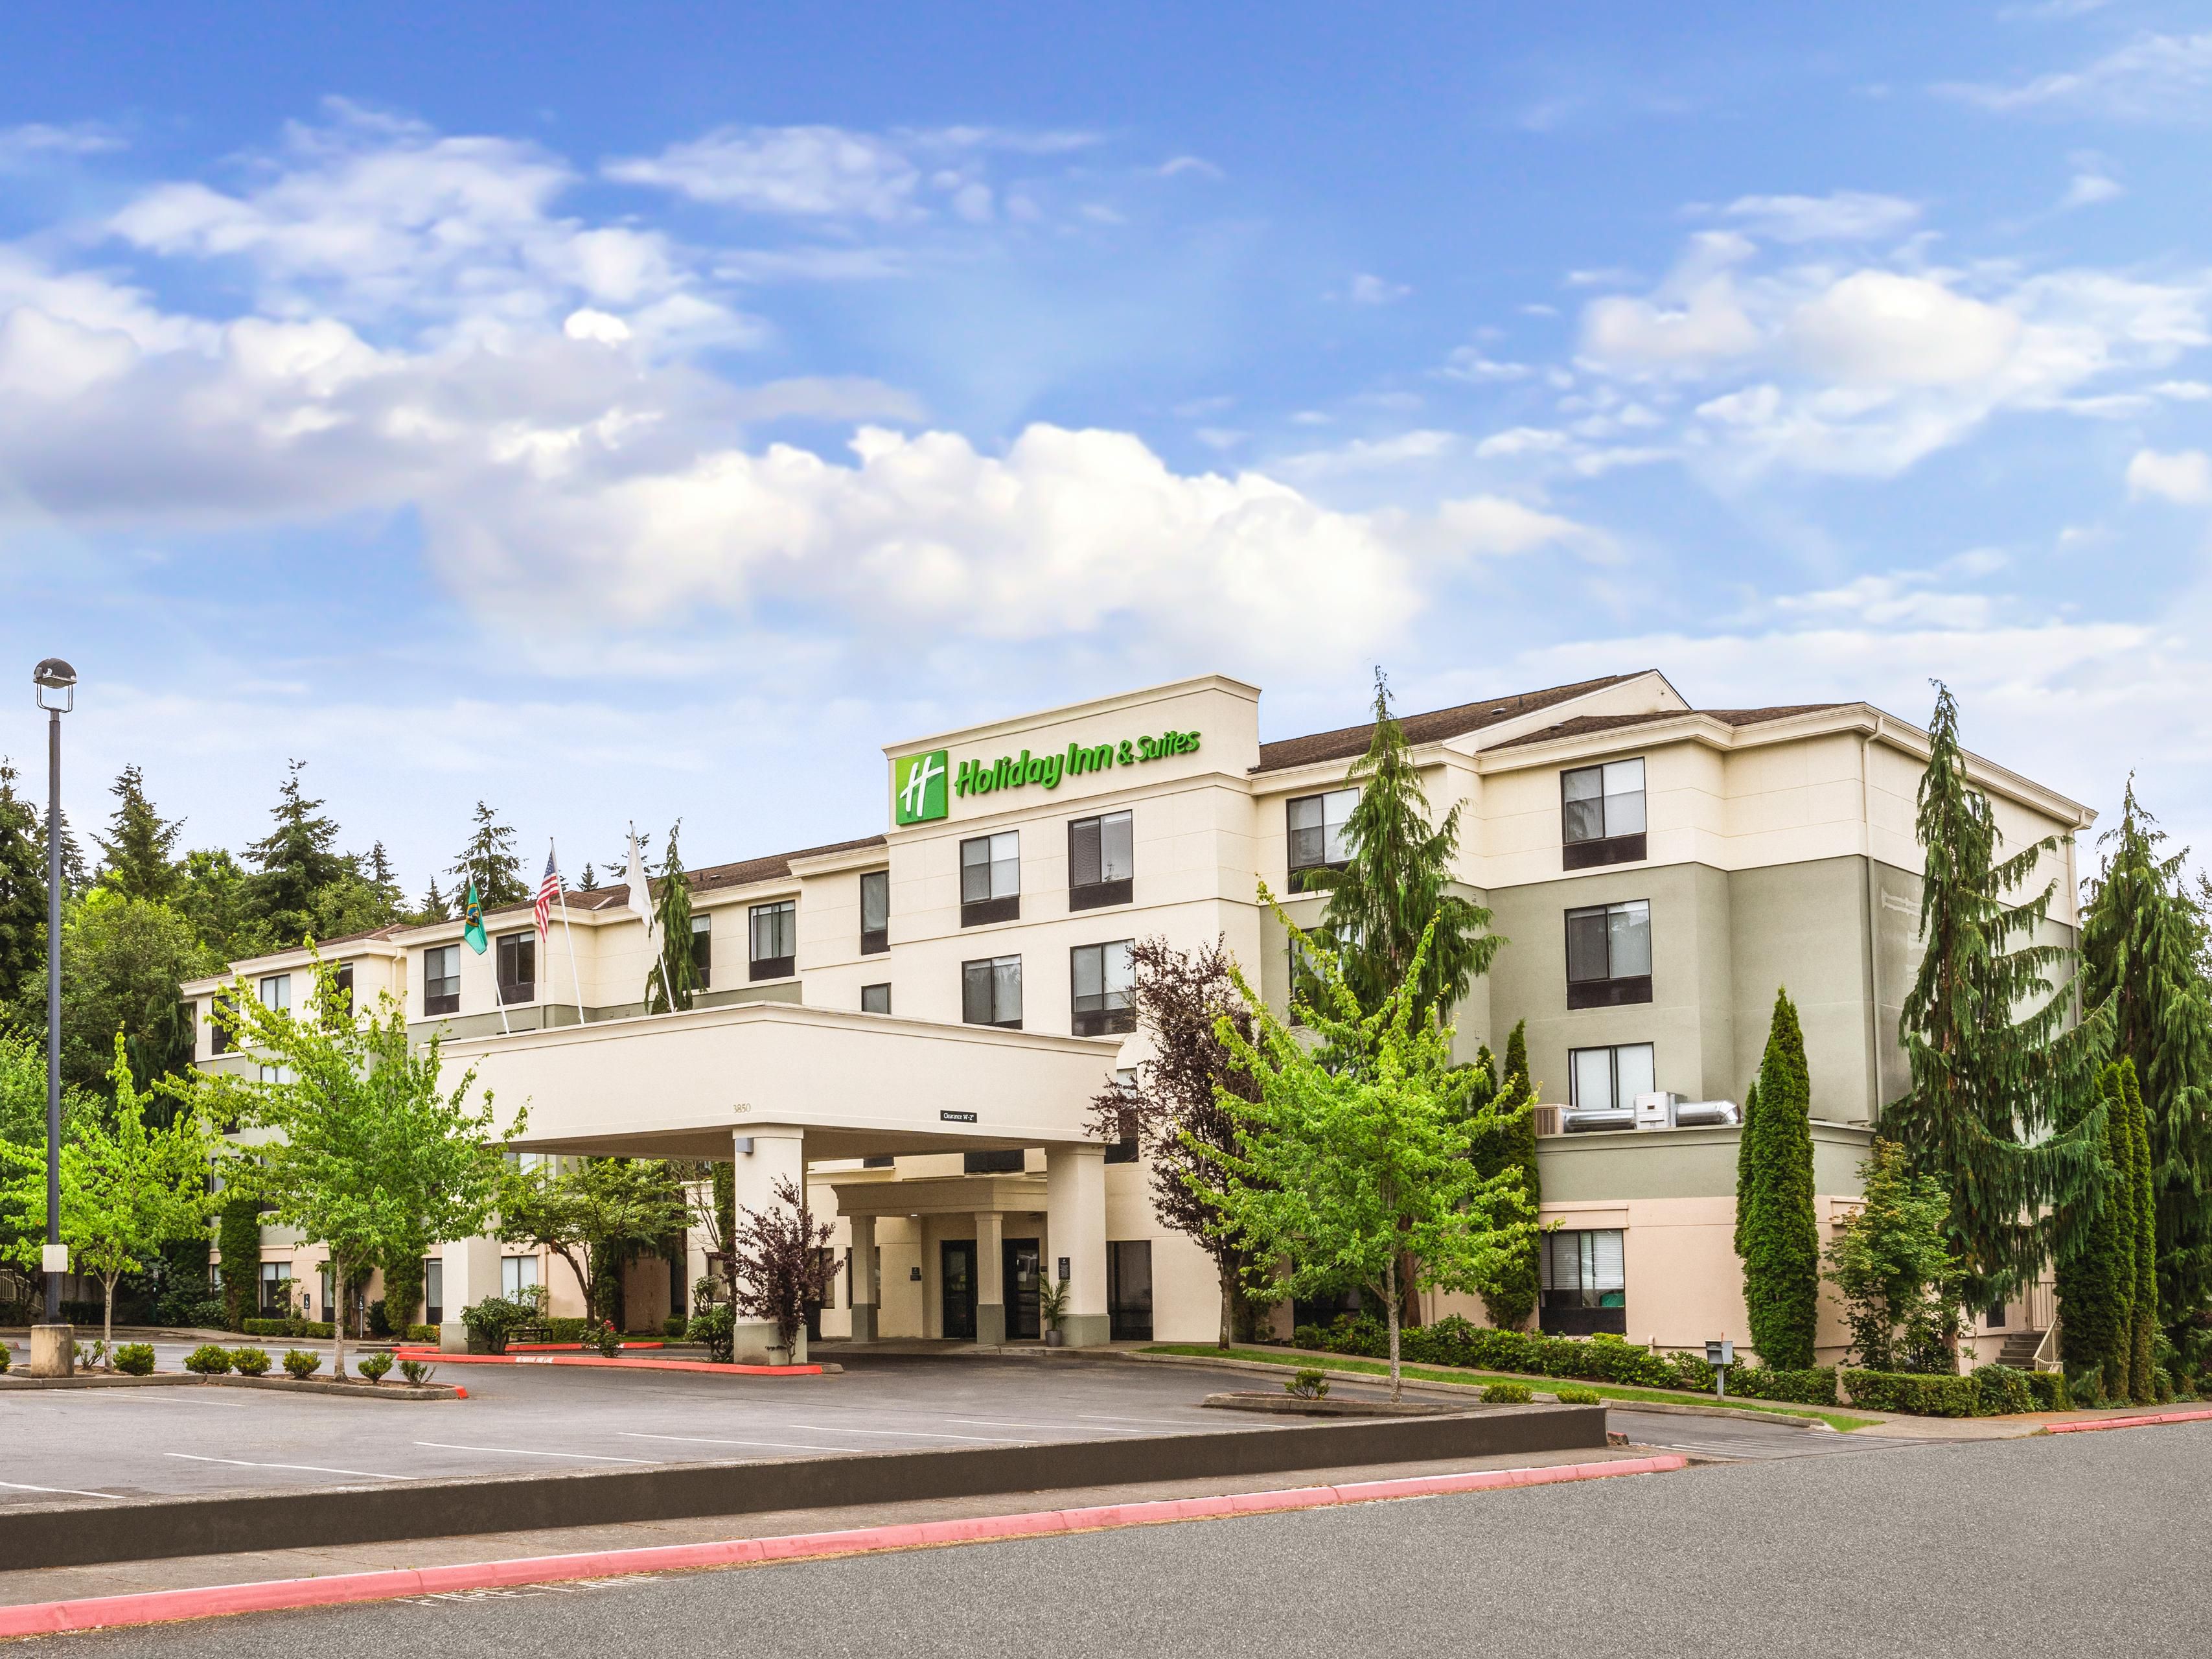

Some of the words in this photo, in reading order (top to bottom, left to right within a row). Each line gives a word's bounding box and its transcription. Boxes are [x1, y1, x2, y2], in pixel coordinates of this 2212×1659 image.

[954, 749, 1065, 797] Holiday
[1065, 743, 1114, 775] Inn
[1116, 739, 1134, 765] &
[1135, 731, 1201, 762] Suites
[733, 1103, 752, 1113] 3850
